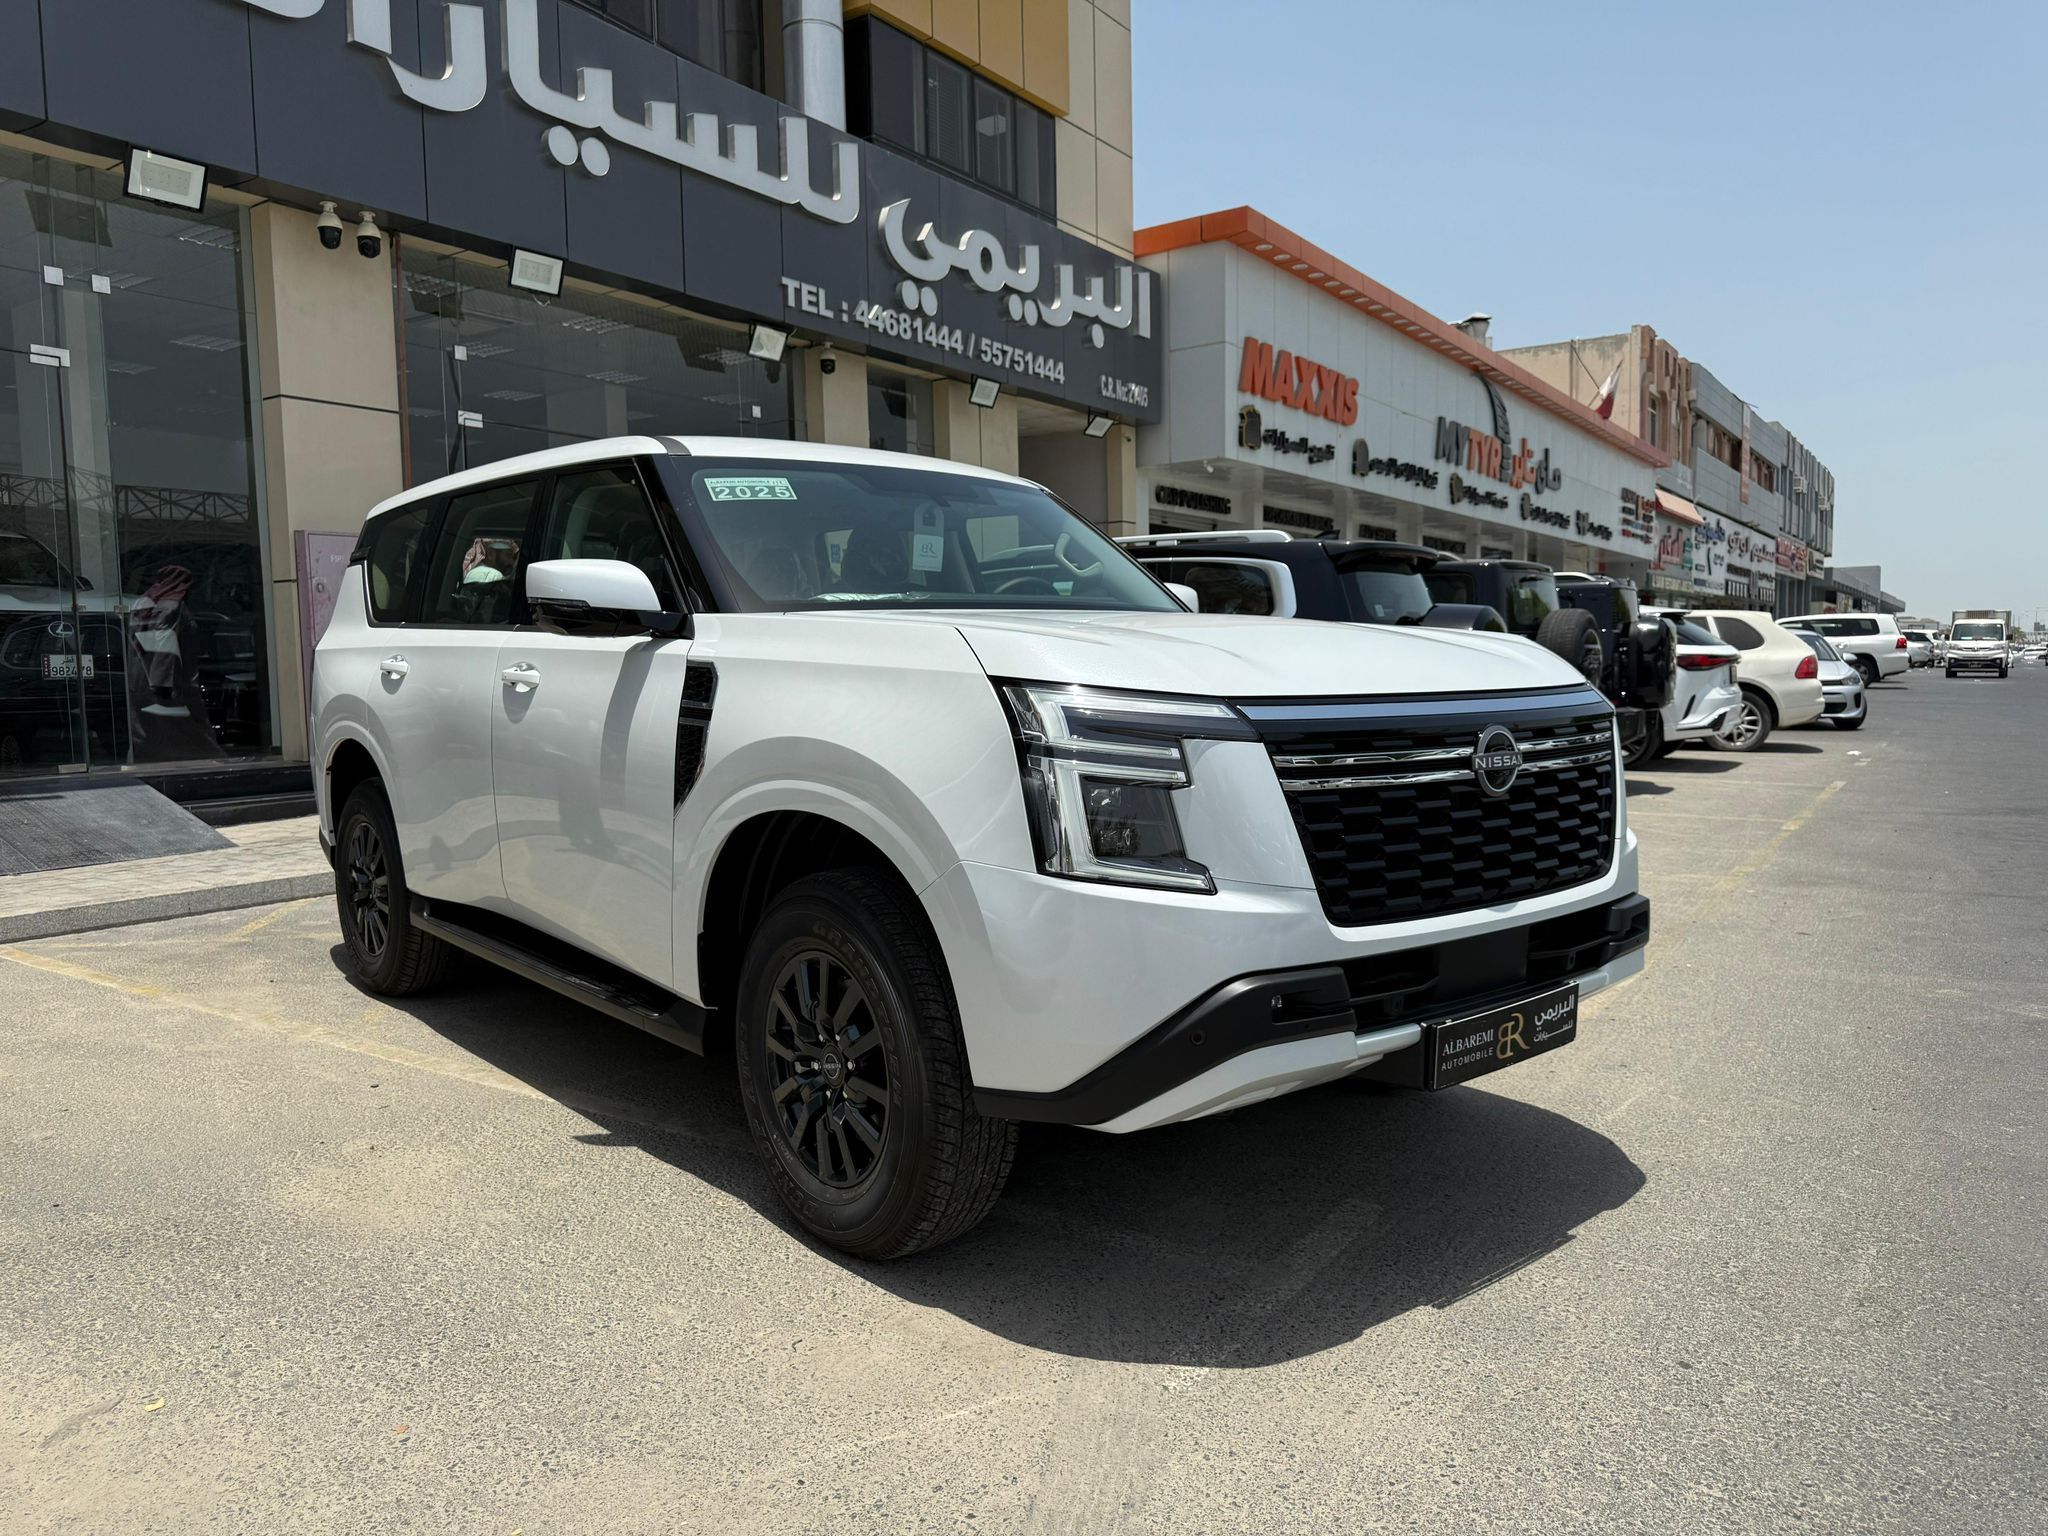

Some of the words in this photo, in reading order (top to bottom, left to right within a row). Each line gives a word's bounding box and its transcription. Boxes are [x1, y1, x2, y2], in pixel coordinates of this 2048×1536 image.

[240, 0, 861, 224] للسيارا
[878, 197, 1150, 349] البريمي
[782, 276, 834, 319] TEL
[854, 300, 963, 354] 44681444
[980, 337, 1065, 384] 55751444
[1238, 336, 1359, 426] MAXXIS
[715, 486, 790, 498] 2025
[51, 665, 92, 677] 98248
[1475, 755, 1522, 768] NISSAN
[1534, 994, 1575, 1031] البريمي
[1442, 1028, 1494, 1056] ALBAREMI
[1533, 1019, 1573, 1043] للسيارات
[1441, 1047, 1494, 1071] AUTOMOBILE
